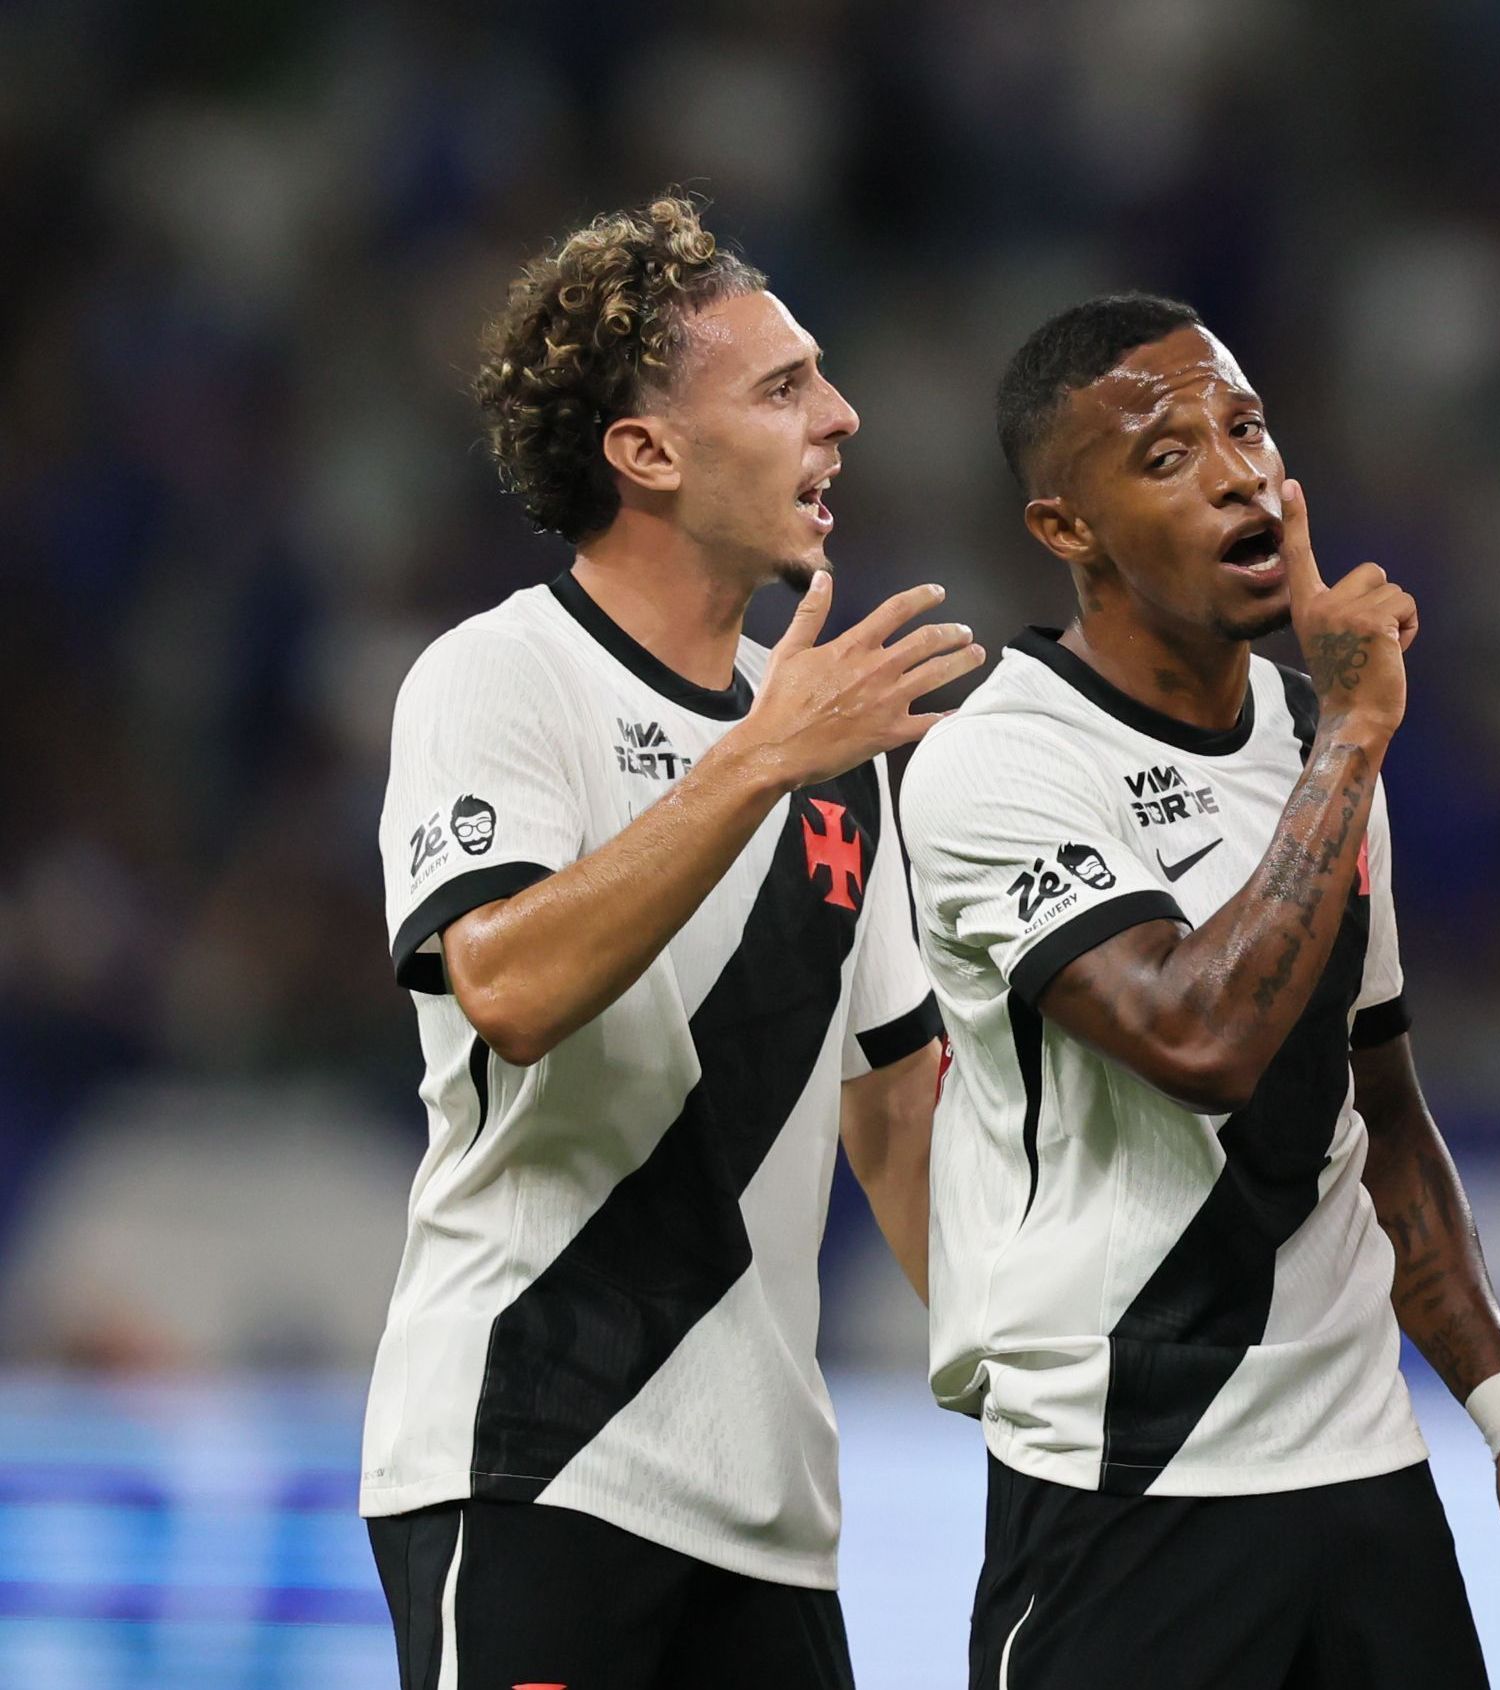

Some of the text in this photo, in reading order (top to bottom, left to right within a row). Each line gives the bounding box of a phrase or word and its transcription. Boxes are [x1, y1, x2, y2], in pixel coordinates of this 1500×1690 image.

[616, 717, 673, 748] VIVA
[1124, 765, 1188, 798] VIVA
[1130, 787, 1220, 827] SORTE
[409, 812, 448, 878] Zé
[1006, 858, 1072, 922] Zé
[1024, 892, 1078, 934] DELIVERY
